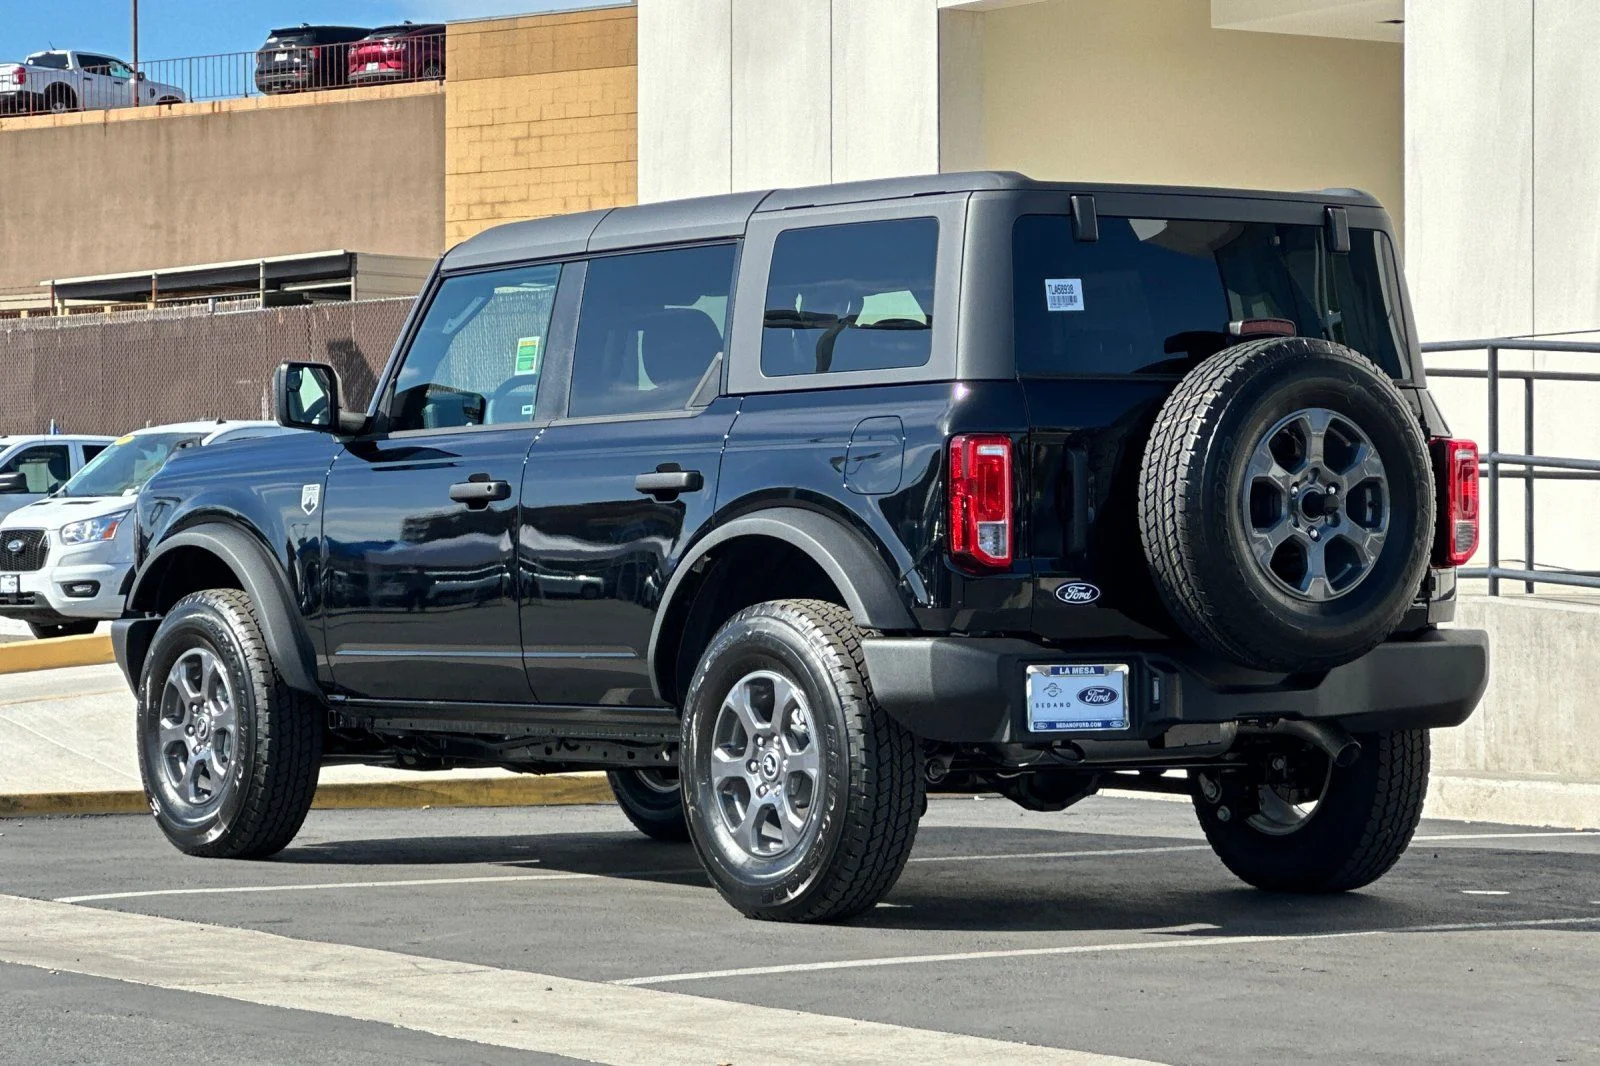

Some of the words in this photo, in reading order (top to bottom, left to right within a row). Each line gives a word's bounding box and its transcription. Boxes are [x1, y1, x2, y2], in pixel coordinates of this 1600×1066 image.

[1065, 586, 1093, 600] Ford
[1059, 667, 1070, 675] LA
[1085, 689, 1110, 702] Ford
